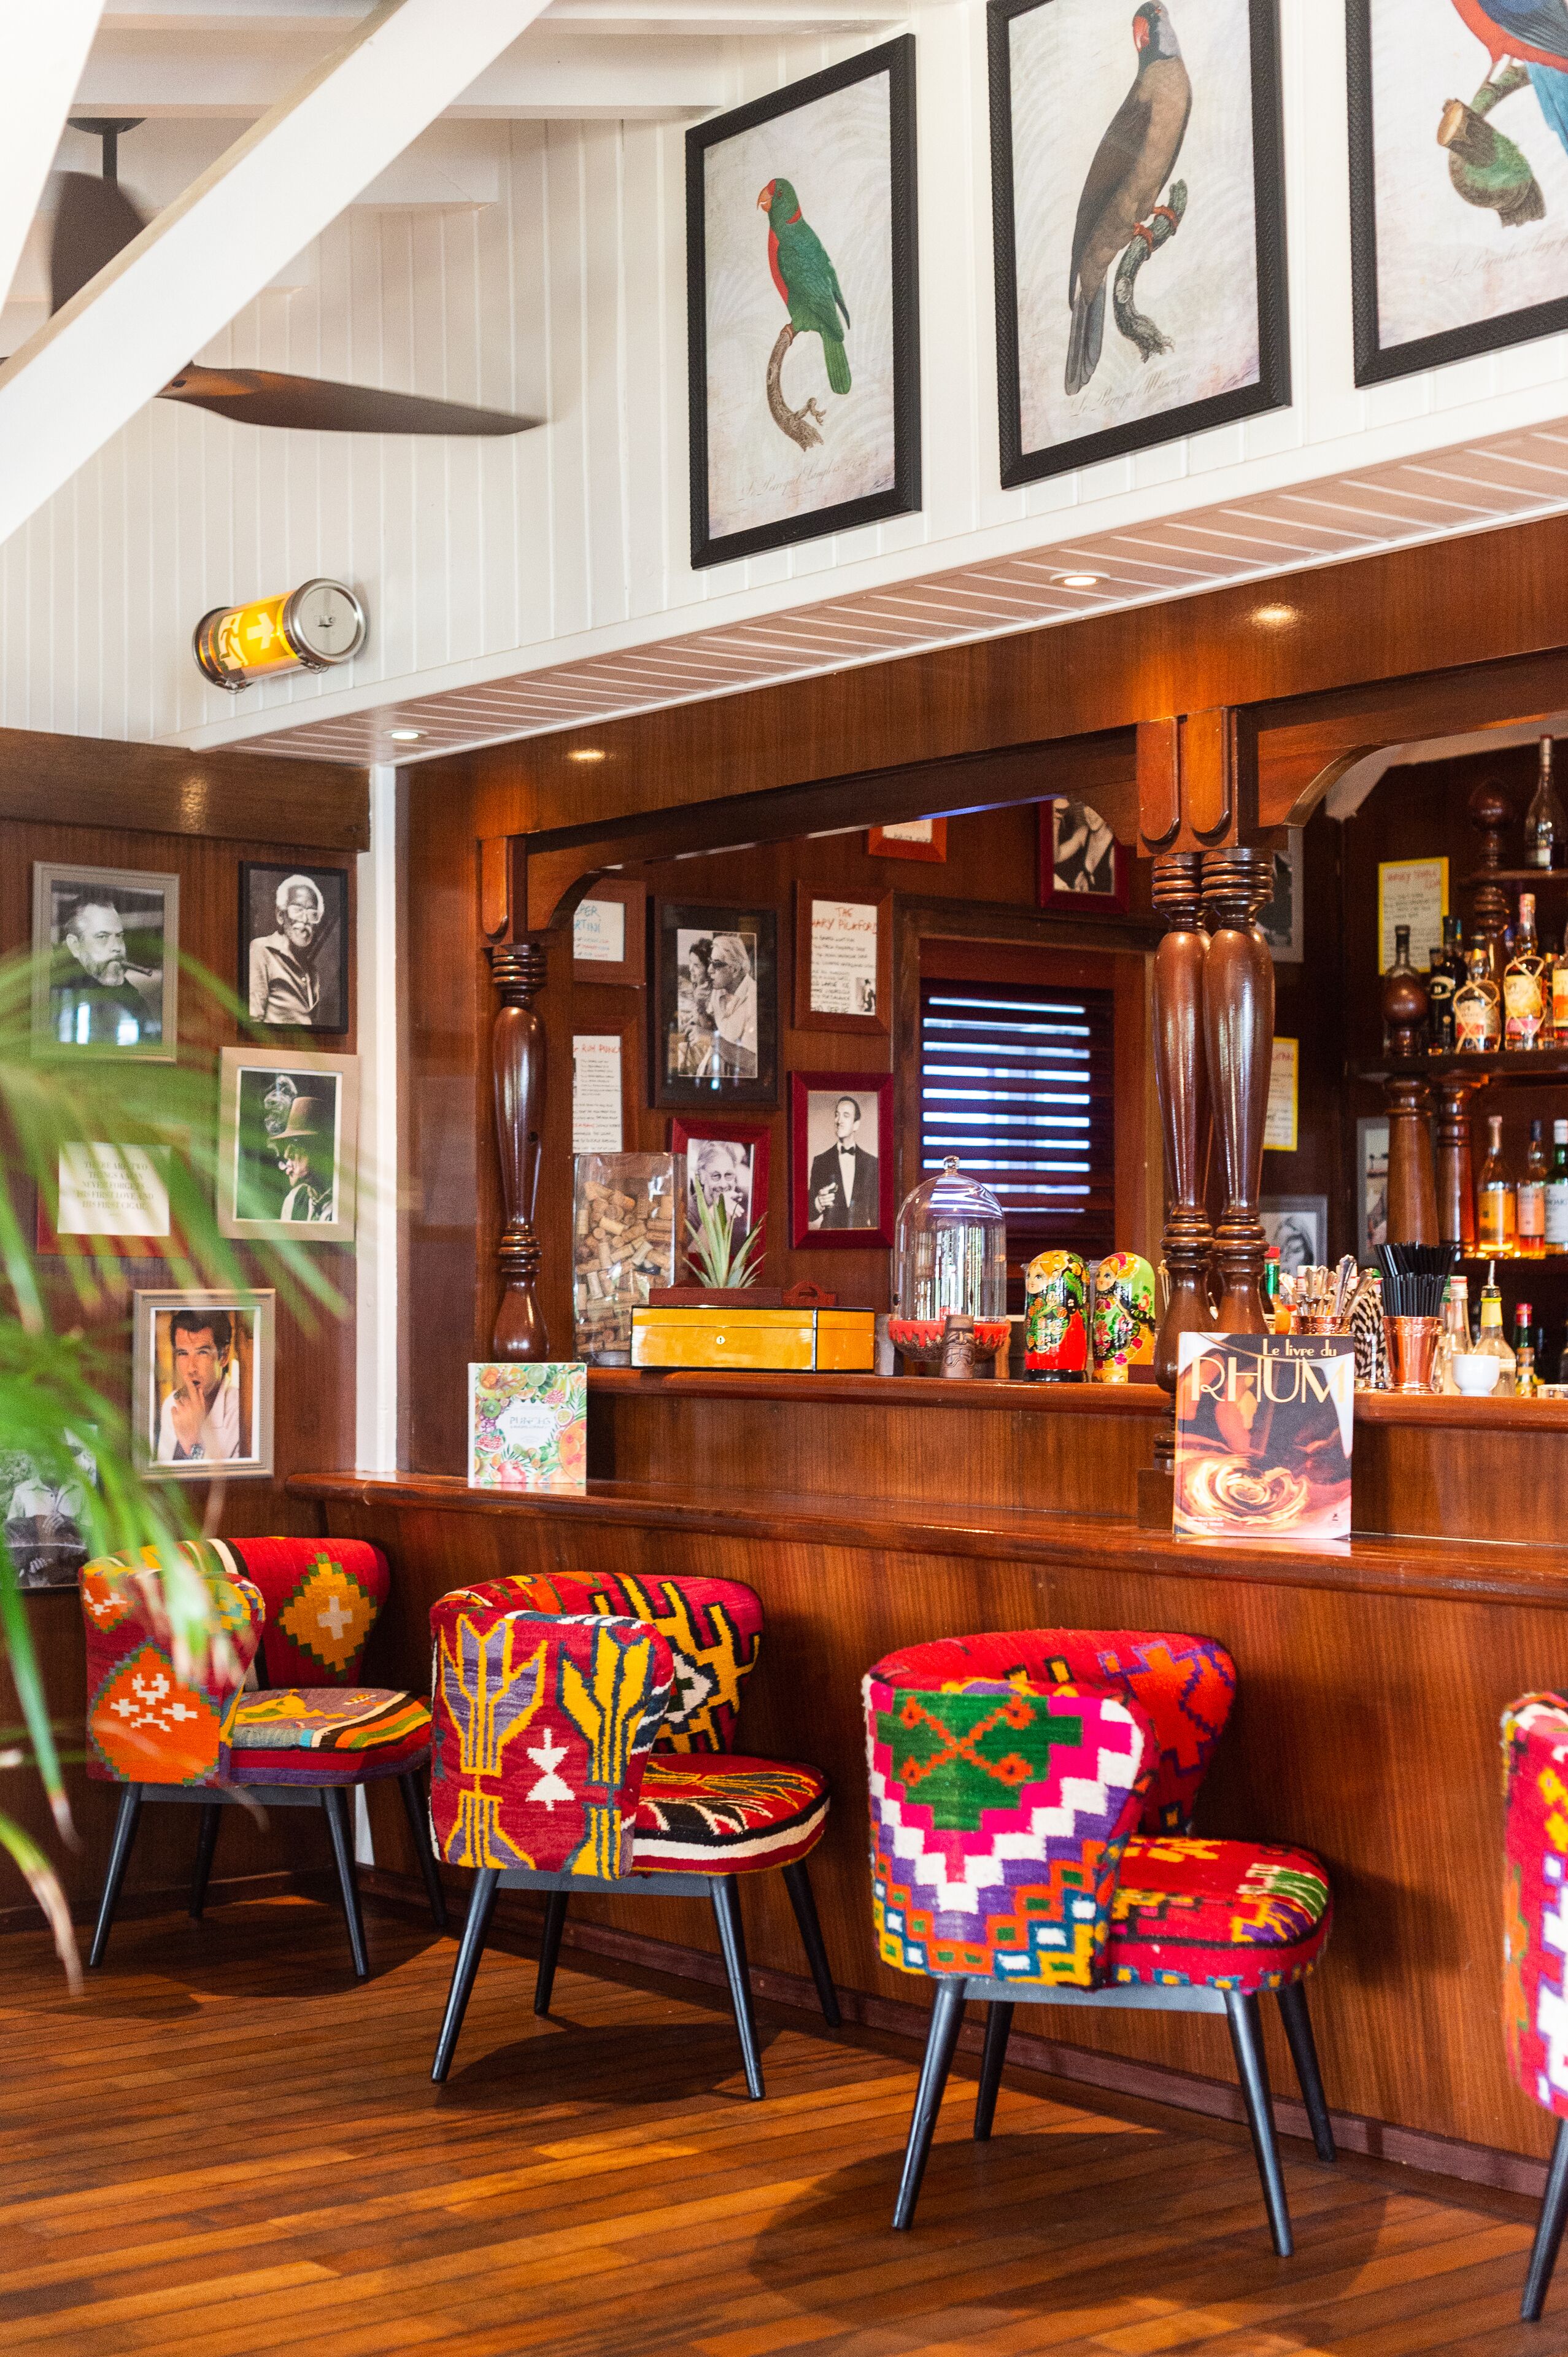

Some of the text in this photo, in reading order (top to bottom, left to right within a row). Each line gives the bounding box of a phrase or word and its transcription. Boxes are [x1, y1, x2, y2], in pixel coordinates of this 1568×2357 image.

[85, 1161, 110, 1169] THRE
[1262, 1338, 1337, 1357] Le livre du
[1191, 1357, 1346, 1403] RHUM
